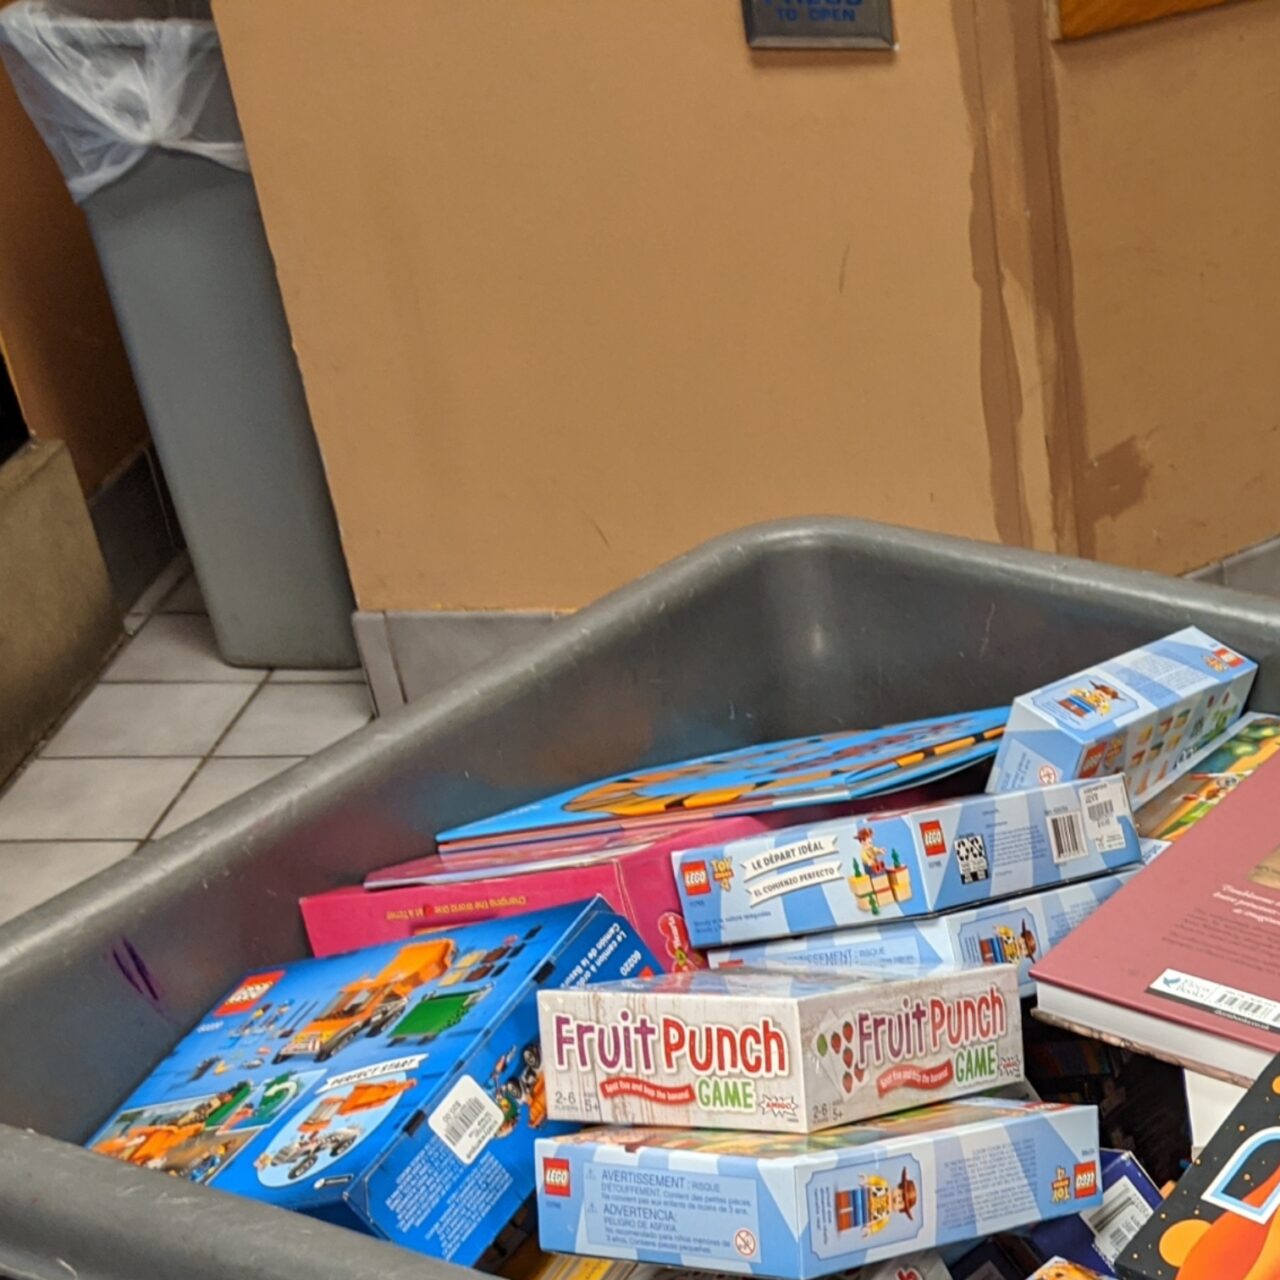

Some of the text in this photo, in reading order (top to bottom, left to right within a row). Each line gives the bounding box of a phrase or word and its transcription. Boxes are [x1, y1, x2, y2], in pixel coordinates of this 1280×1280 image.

[777, 8, 856, 21] TO OPEN
[923, 828, 942, 845] LEGO
[751, 838, 823, 870] LE DÉPART IDÉAL
[684, 856, 732, 886] LEGO TOY
[857, 985, 1004, 1065] Fruit Punch
[553, 1008, 785, 1074] Fruit Punch
[955, 1043, 996, 1082] GAME
[554, 1091, 576, 1104] 2-6
[698, 1079, 753, 1108] GAME
[545, 1167, 567, 1183] LEGO
[601, 1169, 720, 1192] AVERTISSEMENT RISQUE
[602, 1203, 676, 1221] ADVERTENCIA:
[603, 1216, 636, 1228] PELIGRO
[637, 1220, 648, 1229] DE
